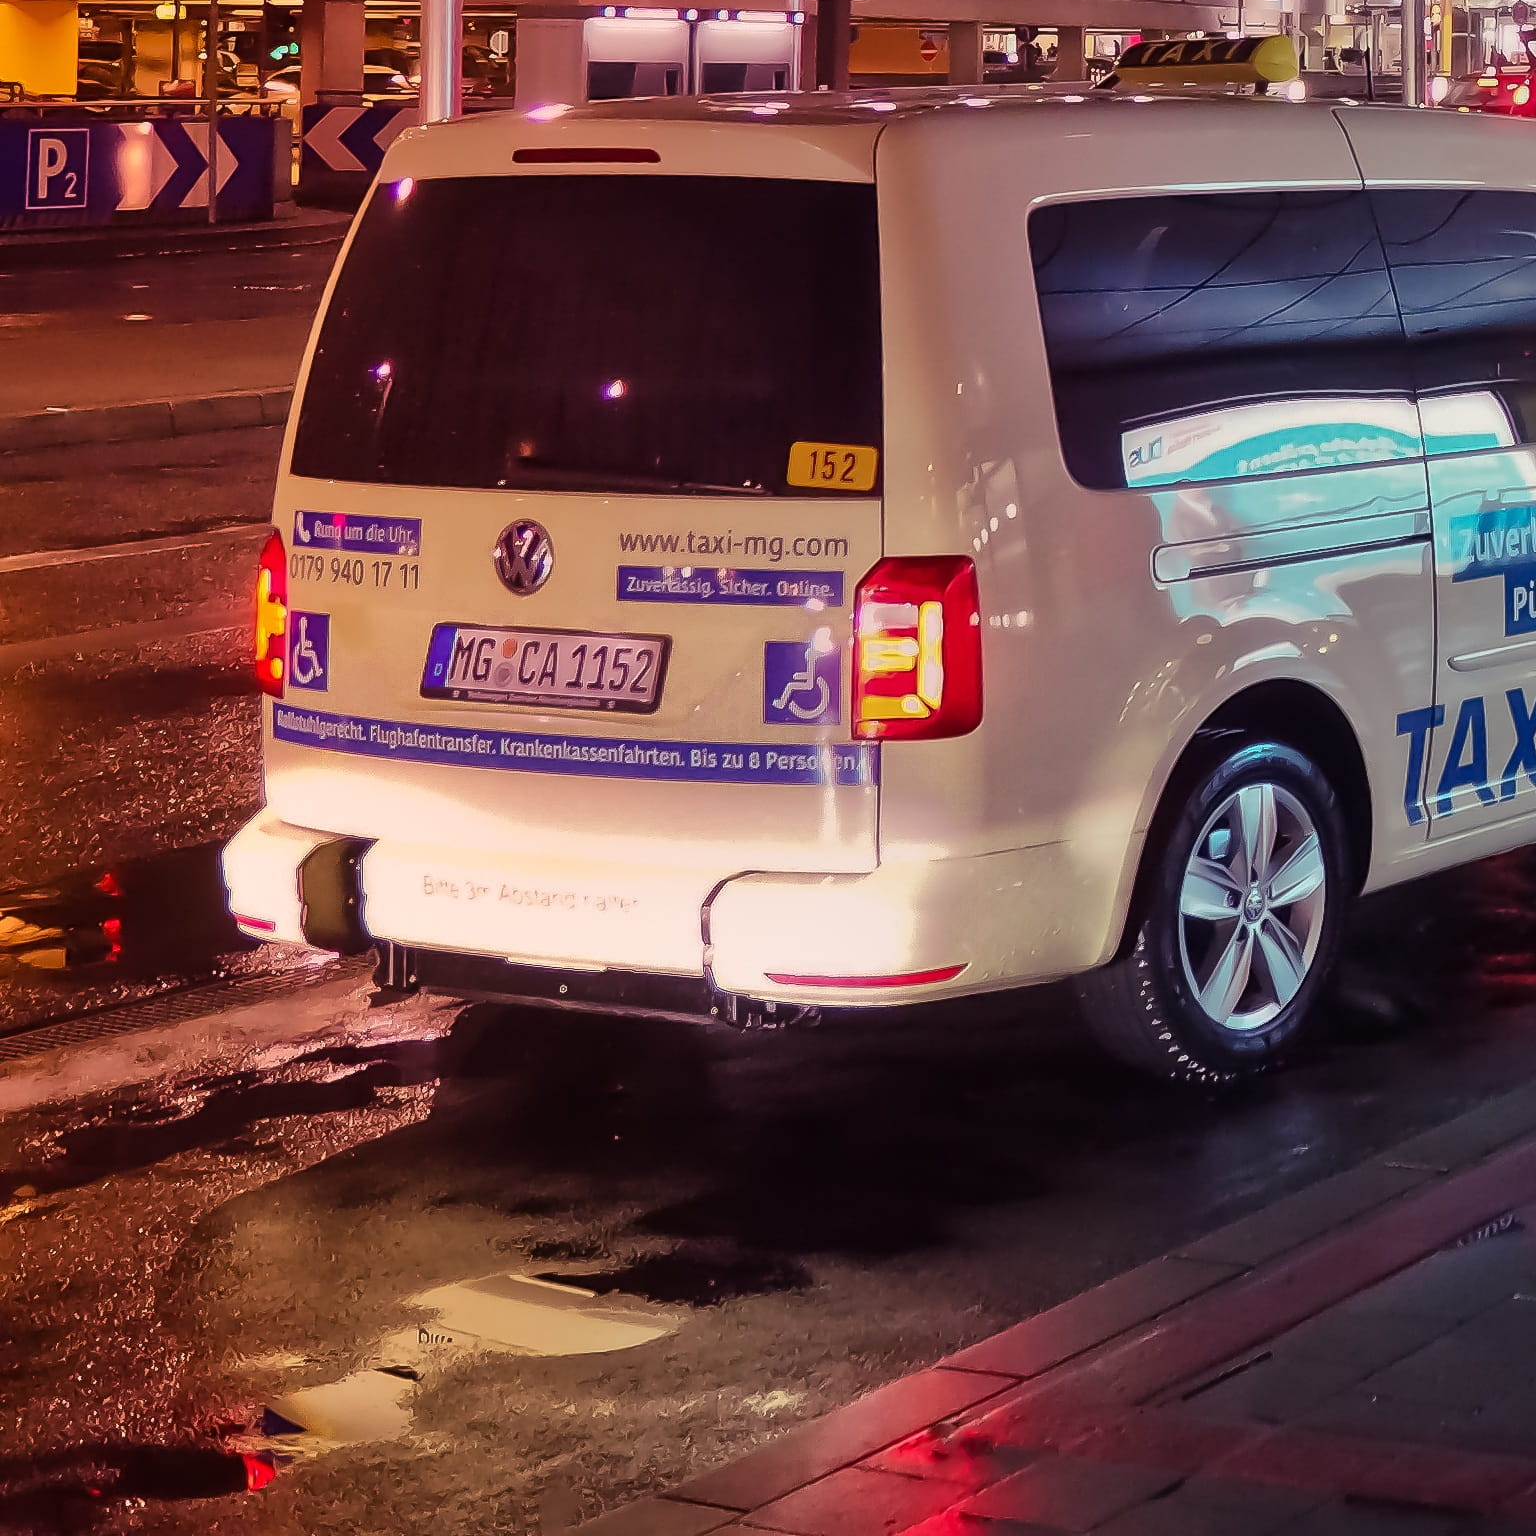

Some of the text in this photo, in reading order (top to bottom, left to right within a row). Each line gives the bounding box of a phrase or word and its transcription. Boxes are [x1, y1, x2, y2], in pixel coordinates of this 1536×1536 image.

[1141, 41, 1243, 64] TAXI
[38, 138, 78, 199] P2
[809, 450, 856, 483] 152
[344, 525, 363, 541] um
[366, 524, 385, 542] die
[389, 525, 417, 544] Uhr.
[619, 530, 849, 562] www.taxi-mg.com
[289, 554, 420, 590] 0179 940 17 11
[719, 577, 772, 597] Sicher.
[776, 580, 835, 597] Online.
[450, 636, 655, 694] MG CA 1152
[370, 724, 496, 754] Flughafentransfer.
[500, 737, 685, 766] Krankenkassenfahrten.
[690, 748, 718, 768] Bis
[722, 753, 744, 769] zu
[749, 752, 760, 769] 8
[766, 751, 858, 771] Persoen.
